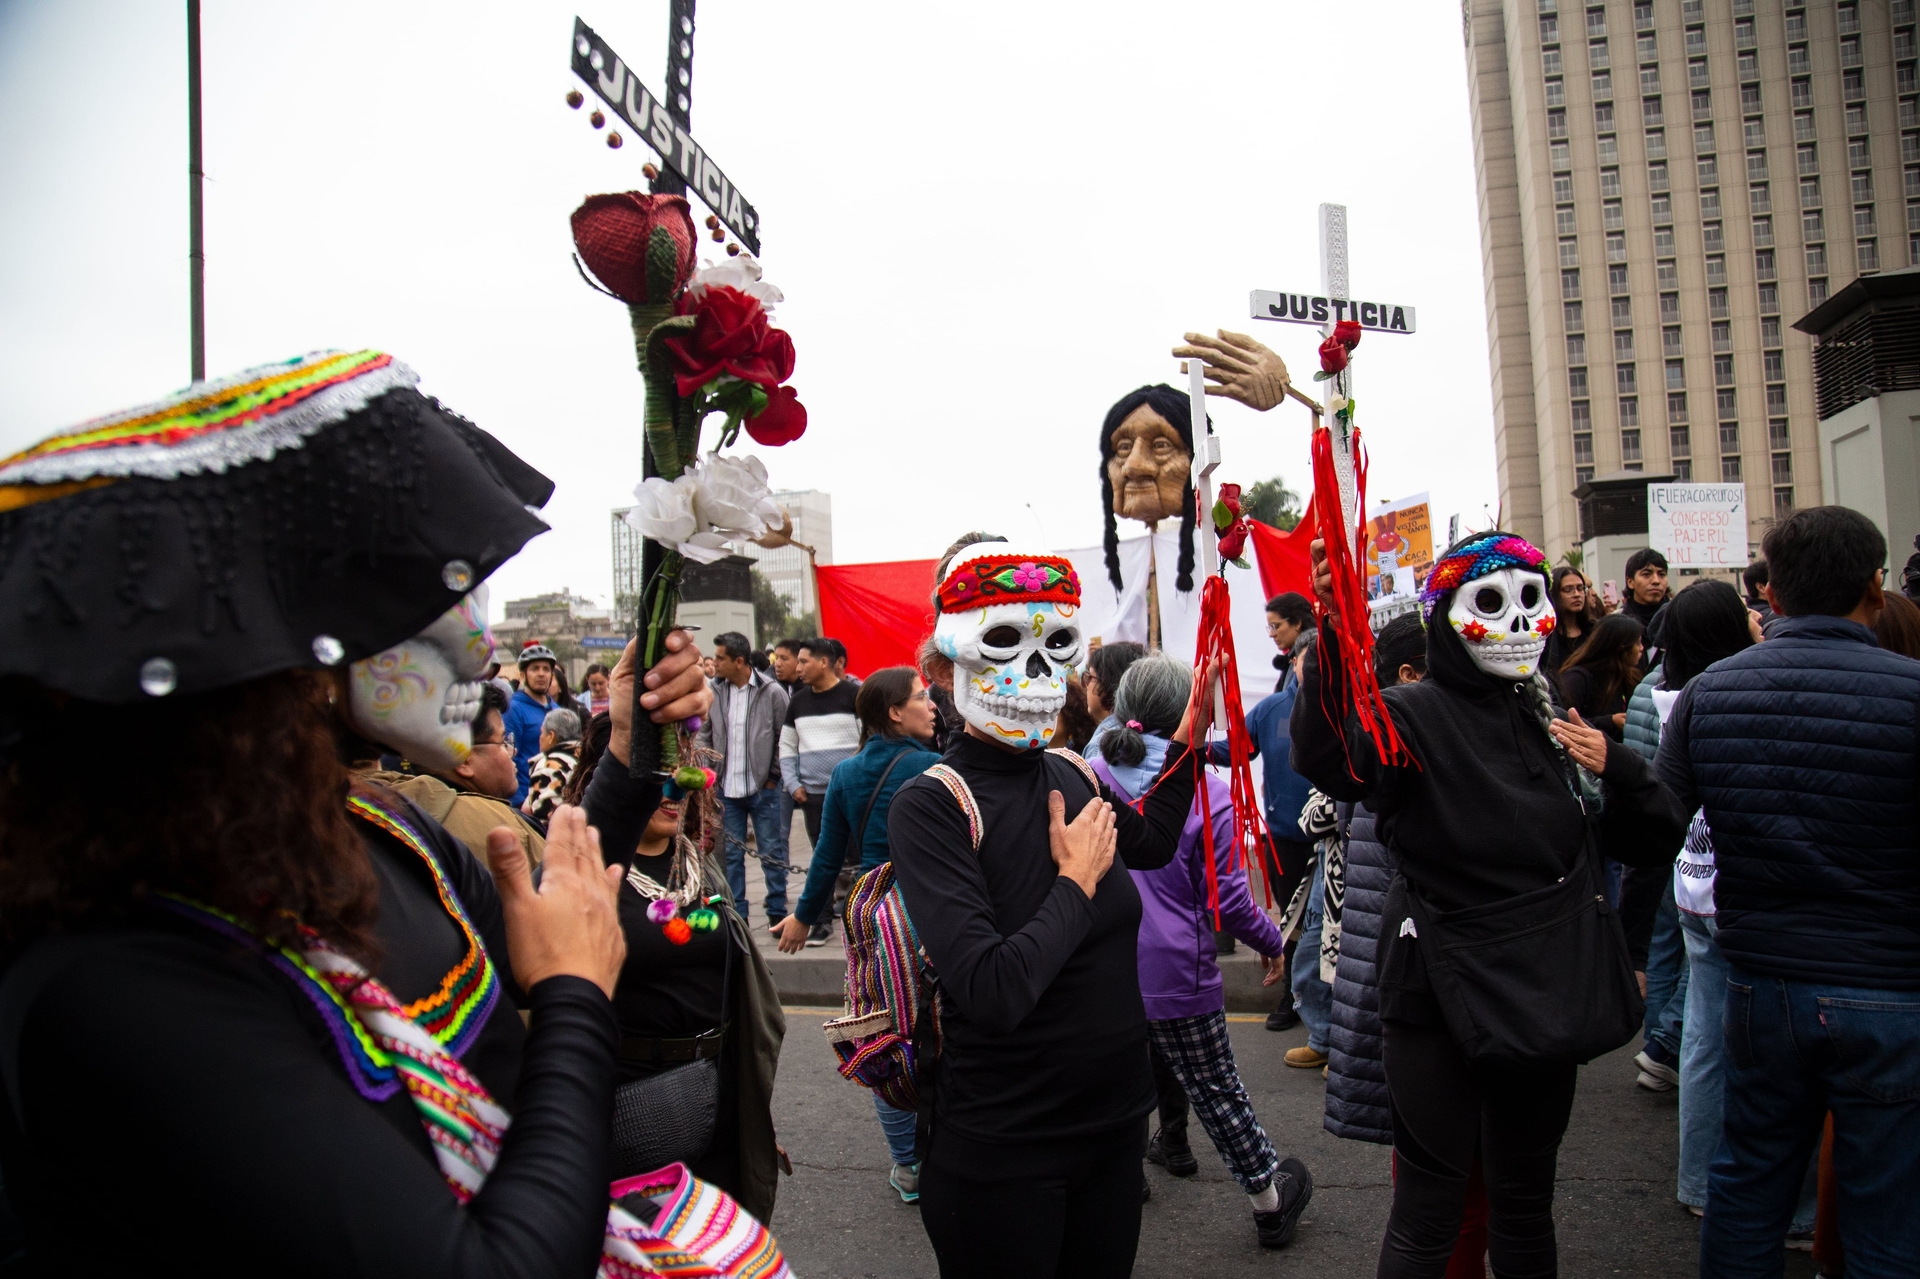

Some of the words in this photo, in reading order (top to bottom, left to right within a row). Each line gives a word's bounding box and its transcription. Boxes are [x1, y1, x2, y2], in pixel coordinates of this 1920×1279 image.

[598, 57, 744, 236] JUSTICIA
[1269, 293, 1407, 330] JUSTICIA
[1399, 506, 1424, 518] NUNCA
[1670, 511, 1729, 526] CONGRESO
[1396, 520, 1418, 531] VISTO
[1407, 523, 1428, 534] TANTA
[1674, 528, 1728, 543] PAJERIL
[1404, 549, 1427, 561] CACA
